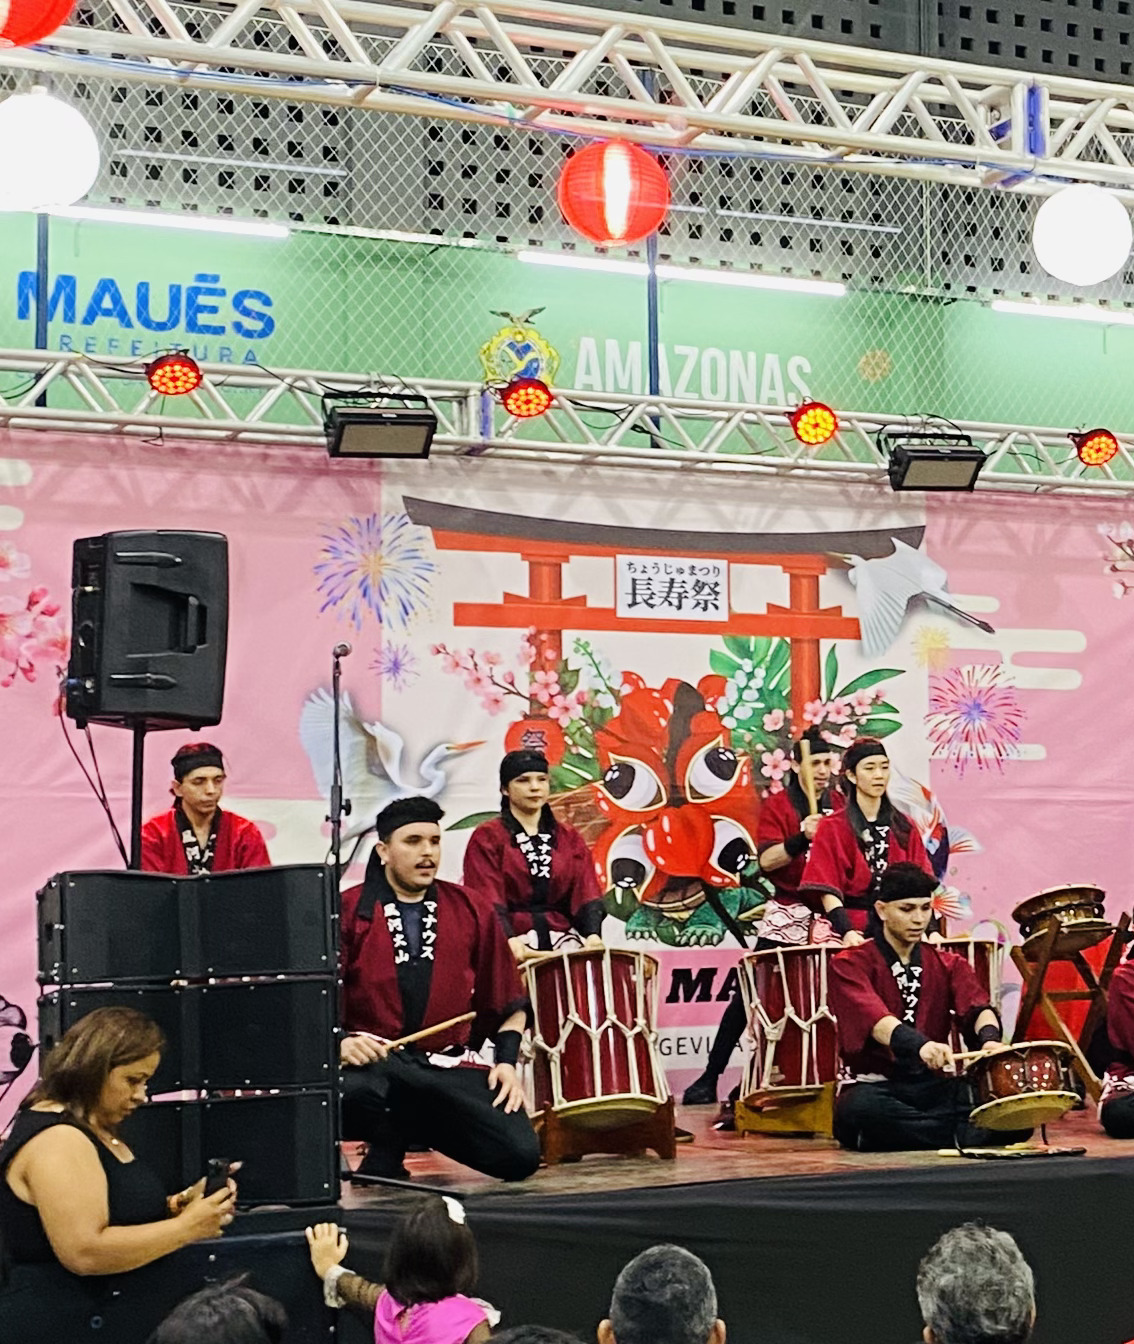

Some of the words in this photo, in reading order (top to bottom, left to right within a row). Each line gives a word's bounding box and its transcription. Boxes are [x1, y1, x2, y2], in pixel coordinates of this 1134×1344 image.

[626, 561, 721, 577] ちょうじゅまつり
[624, 577, 721, 612] 長寿祭
[538, 833, 552, 878] マナウス
[420, 900, 438, 961] マナウス
[665, 967, 745, 1003] MA
[902, 966, 923, 1023] マナウス
